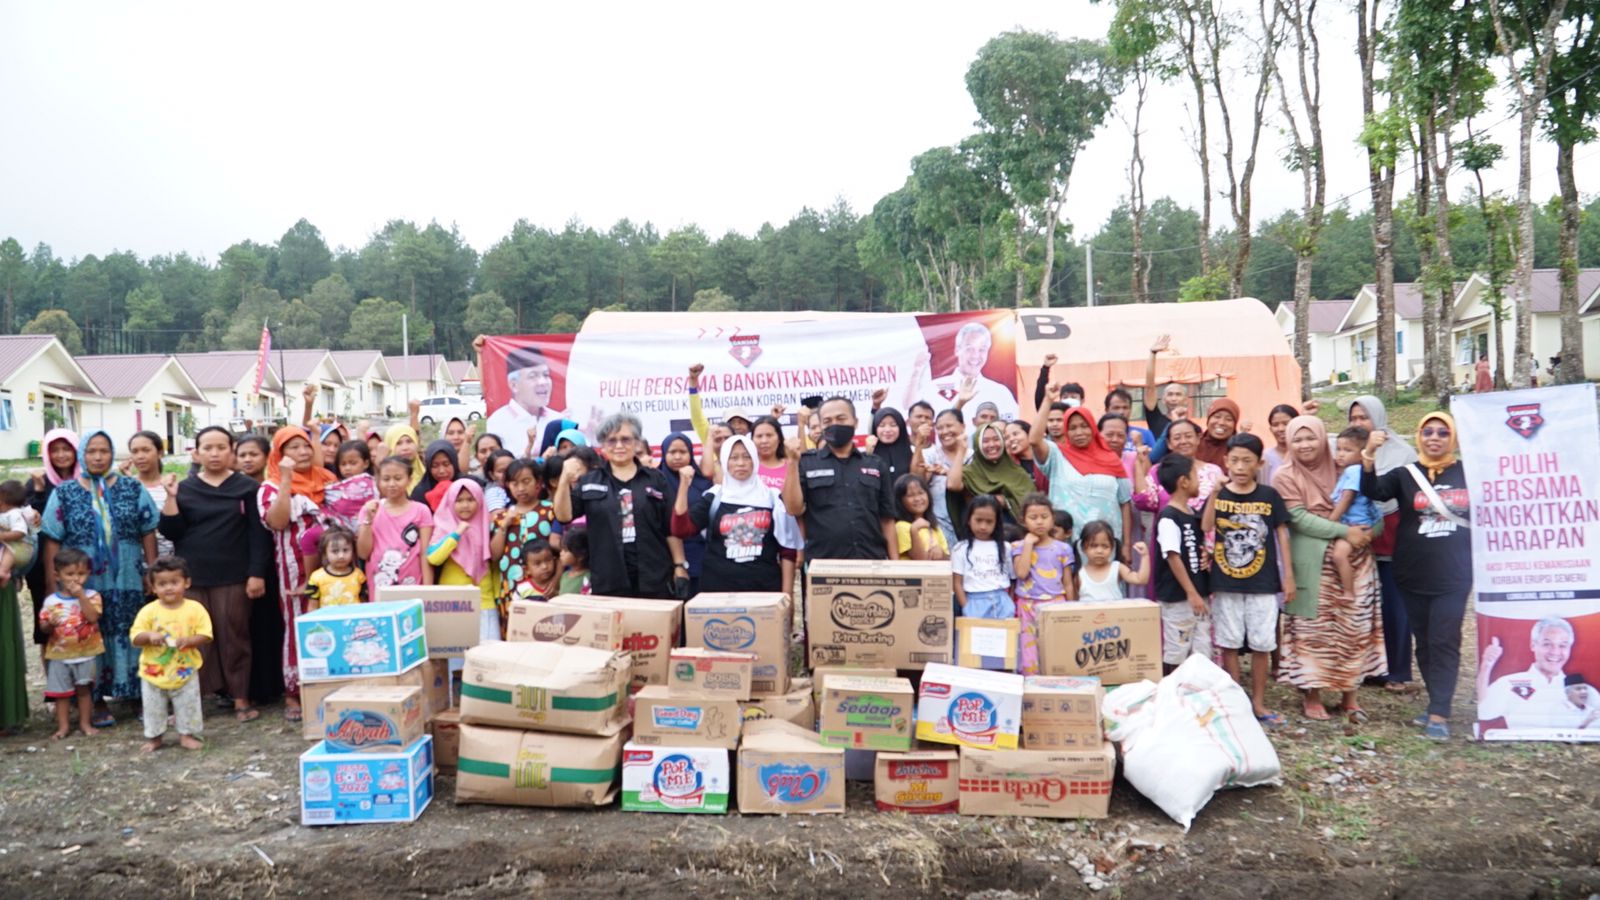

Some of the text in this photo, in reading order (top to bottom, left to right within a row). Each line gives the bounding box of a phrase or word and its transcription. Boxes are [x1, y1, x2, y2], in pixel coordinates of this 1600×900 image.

[1020, 314, 1071, 341] B
[600, 378, 640, 398] PULIH
[723, 369, 824, 392] BANGKITKAN
[827, 365, 896, 386] HARAPAN
[620, 401, 642, 414] AKSI
[645, 399, 679, 412] PEDULI
[757, 393, 797, 407] KORBAN
[1498, 452, 1558, 476] PULIH
[1482, 475, 1582, 503] BERSAMA
[1215, 499, 1272, 516] OUTSIDERS
[1475, 499, 1600, 528] BANGKITKAN
[1487, 526, 1585, 552] HARAPAN
[1082, 626, 1121, 644] SUKRO
[1075, 638, 1131, 668] OVEN
[837, 702, 901, 717] Sedaap
[958, 698, 983, 711] POP
[961, 711, 987, 722] MIE
[663, 761, 687, 775] POP
[667, 772, 693, 785] MIE
[767, 771, 819, 797] Club
[911, 781, 928, 792] Mi
[340, 784, 369, 793] 2022
[895, 790, 943, 803] Goreng
[1004, 778, 1067, 802] Qtela
